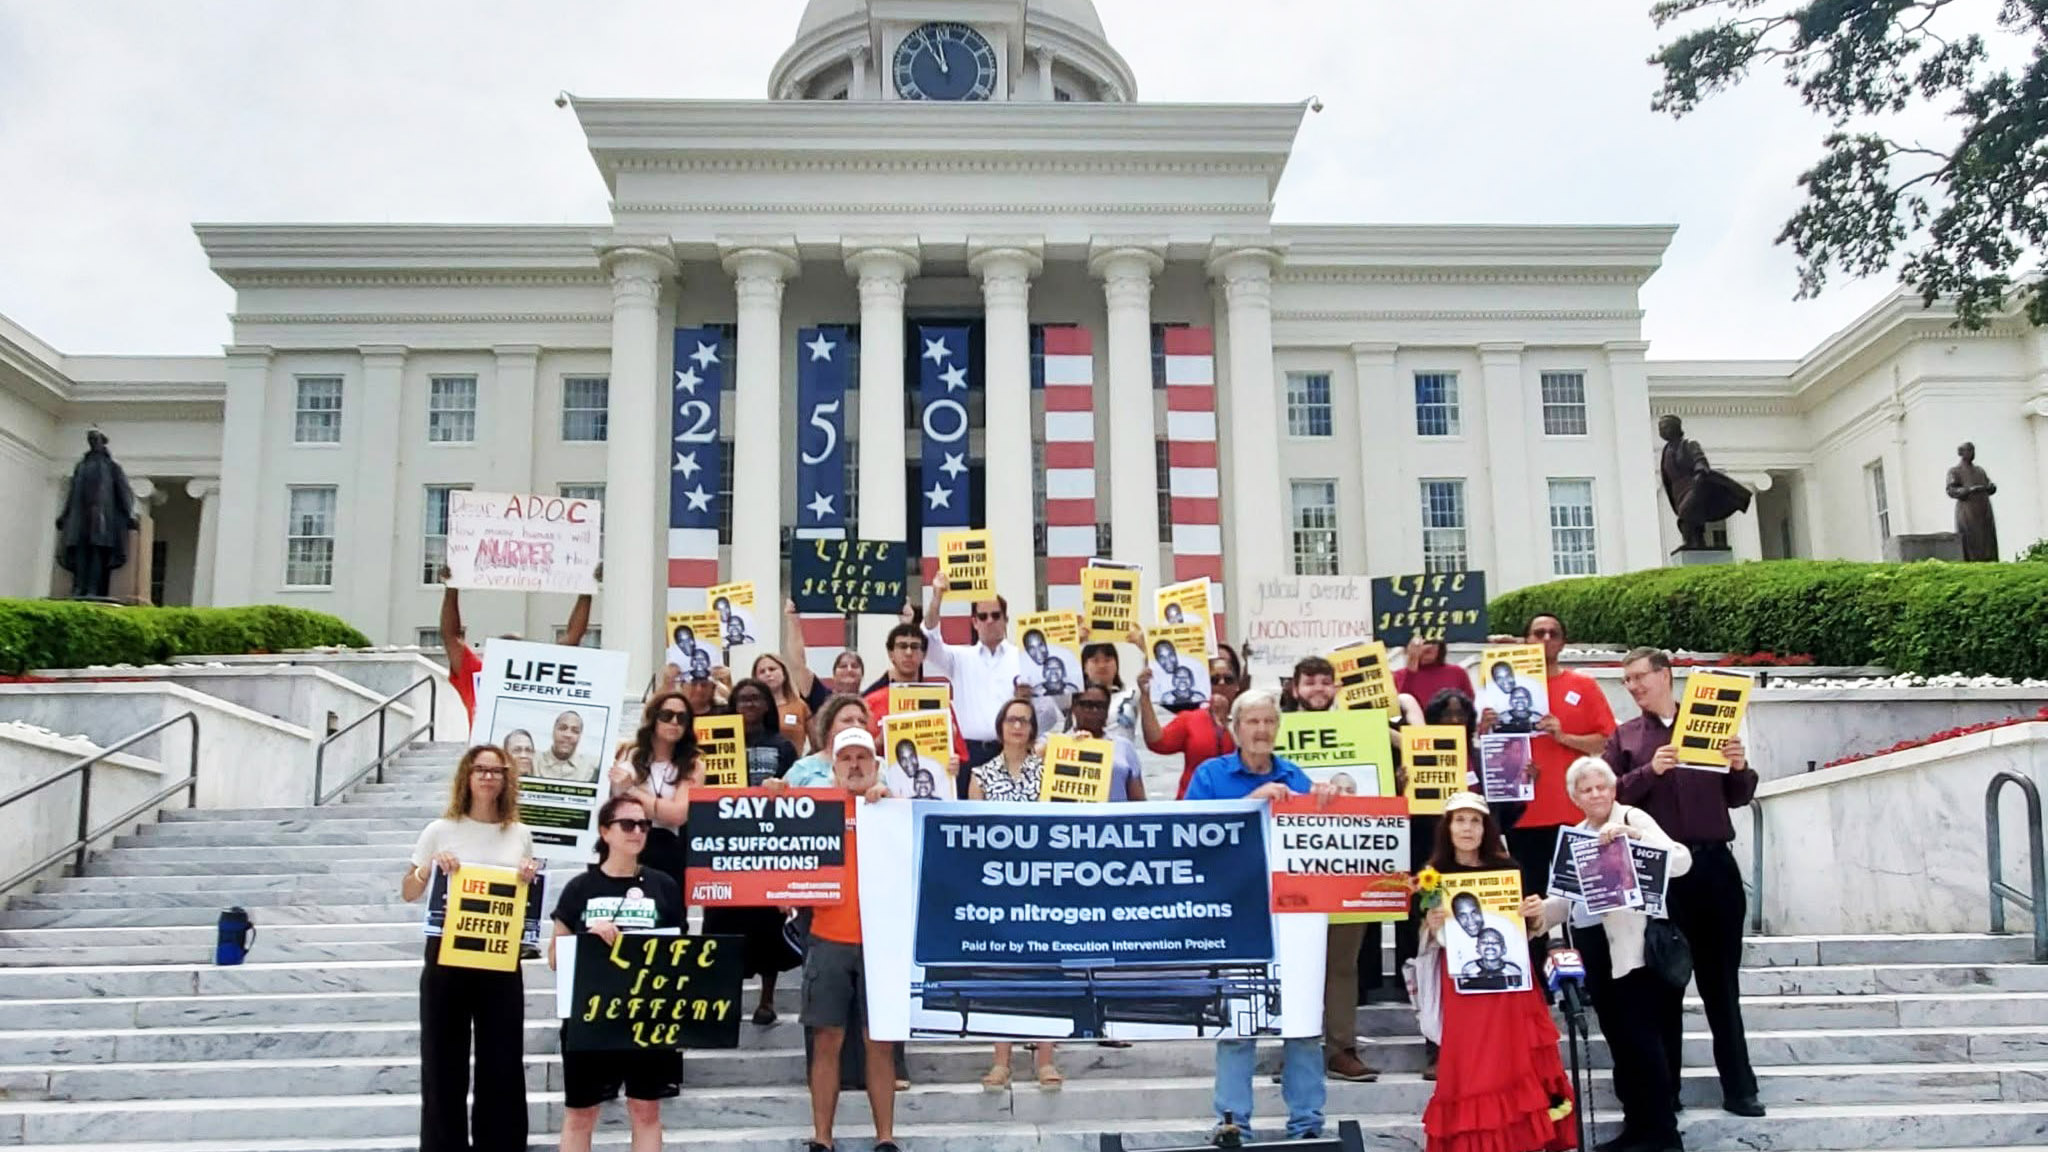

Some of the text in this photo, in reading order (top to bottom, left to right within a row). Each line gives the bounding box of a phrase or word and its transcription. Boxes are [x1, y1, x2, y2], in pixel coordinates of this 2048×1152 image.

[675, 399, 968, 465] 2 5 0
[474, 538, 555, 567] MURDER
[815, 538, 889, 561] LIFE
[946, 541, 963, 552] LIFE
[970, 553, 987, 563] FOR
[832, 561, 872, 578] for
[948, 566, 986, 578] JEFFERY
[801, 578, 900, 596] JEFFERY
[974, 579, 989, 590] LEE
[1093, 579, 1109, 589] LIFE
[1391, 574, 1466, 596] LIFE
[835, 595, 869, 612] LEE
[1116, 593, 1132, 604] FOR
[1091, 605, 1130, 618] JEFFERY
[1116, 620, 1130, 631] LEE
[1379, 609, 1479, 631] JEFFERY
[1249, 619, 1373, 639] UNCONSTITUTIONAL
[505, 658, 578, 685] LIFE
[1336, 659, 1356, 673] LIFE
[1365, 668, 1382, 680] FOR
[503, 682, 592, 699] JEFFERY LEE
[1345, 683, 1385, 702] JEFFERY
[1694, 686, 1716, 700] LIFE
[898, 698, 916, 711] LIFE
[1375, 696, 1390, 709] LEE
[1718, 705, 1737, 718] FOR
[696, 728, 710, 740] IFE
[1686, 719, 1732, 735] JEFFERY
[1274, 729, 1338, 750] IFE
[1411, 738, 1431, 751] LIFE
[718, 742, 736, 754] FOR
[1056, 747, 1076, 761] LIFE
[1333, 750, 1357, 759] LEE
[705, 758, 735, 771] FFERY
[1440, 754, 1457, 767] FOR
[721, 772, 738, 785] LEE
[1082, 766, 1101, 780] FOR
[1414, 771, 1456, 784] JEFFERY
[1051, 779, 1098, 796] JEFFERY
[718, 796, 816, 819] SAY NO
[758, 822, 775, 833] TO
[1276, 815, 1406, 828] EXECUTIONS ARE
[940, 821, 1245, 849] THOU SHALT NOT
[1283, 833, 1400, 850] LEGALIZED
[691, 836, 841, 851] GAS SUFFOCATION
[1636, 848, 1662, 860] NOT
[712, 856, 819, 871] EXECUTIONS!
[1287, 858, 1397, 875] LYNCHING
[981, 859, 1206, 887] SUFFOCATE.
[462, 879, 486, 895] LIFE
[1445, 879, 1457, 887] THE
[1479, 877, 1499, 886] VOTED
[492, 901, 514, 917] FOR
[954, 900, 1232, 924] stop nitrogen executions
[456, 916, 510, 936] JEFFERY
[488, 938, 510, 955] LEE
[609, 933, 718, 970] LIFE
[961, 937, 1226, 954] Paid for by The Execution Intervention Project
[1553, 951, 1581, 966] 12
[630, 968, 690, 996] for
[583, 995, 732, 1022] JEFFERY
[632, 1022, 681, 1048] LEE
